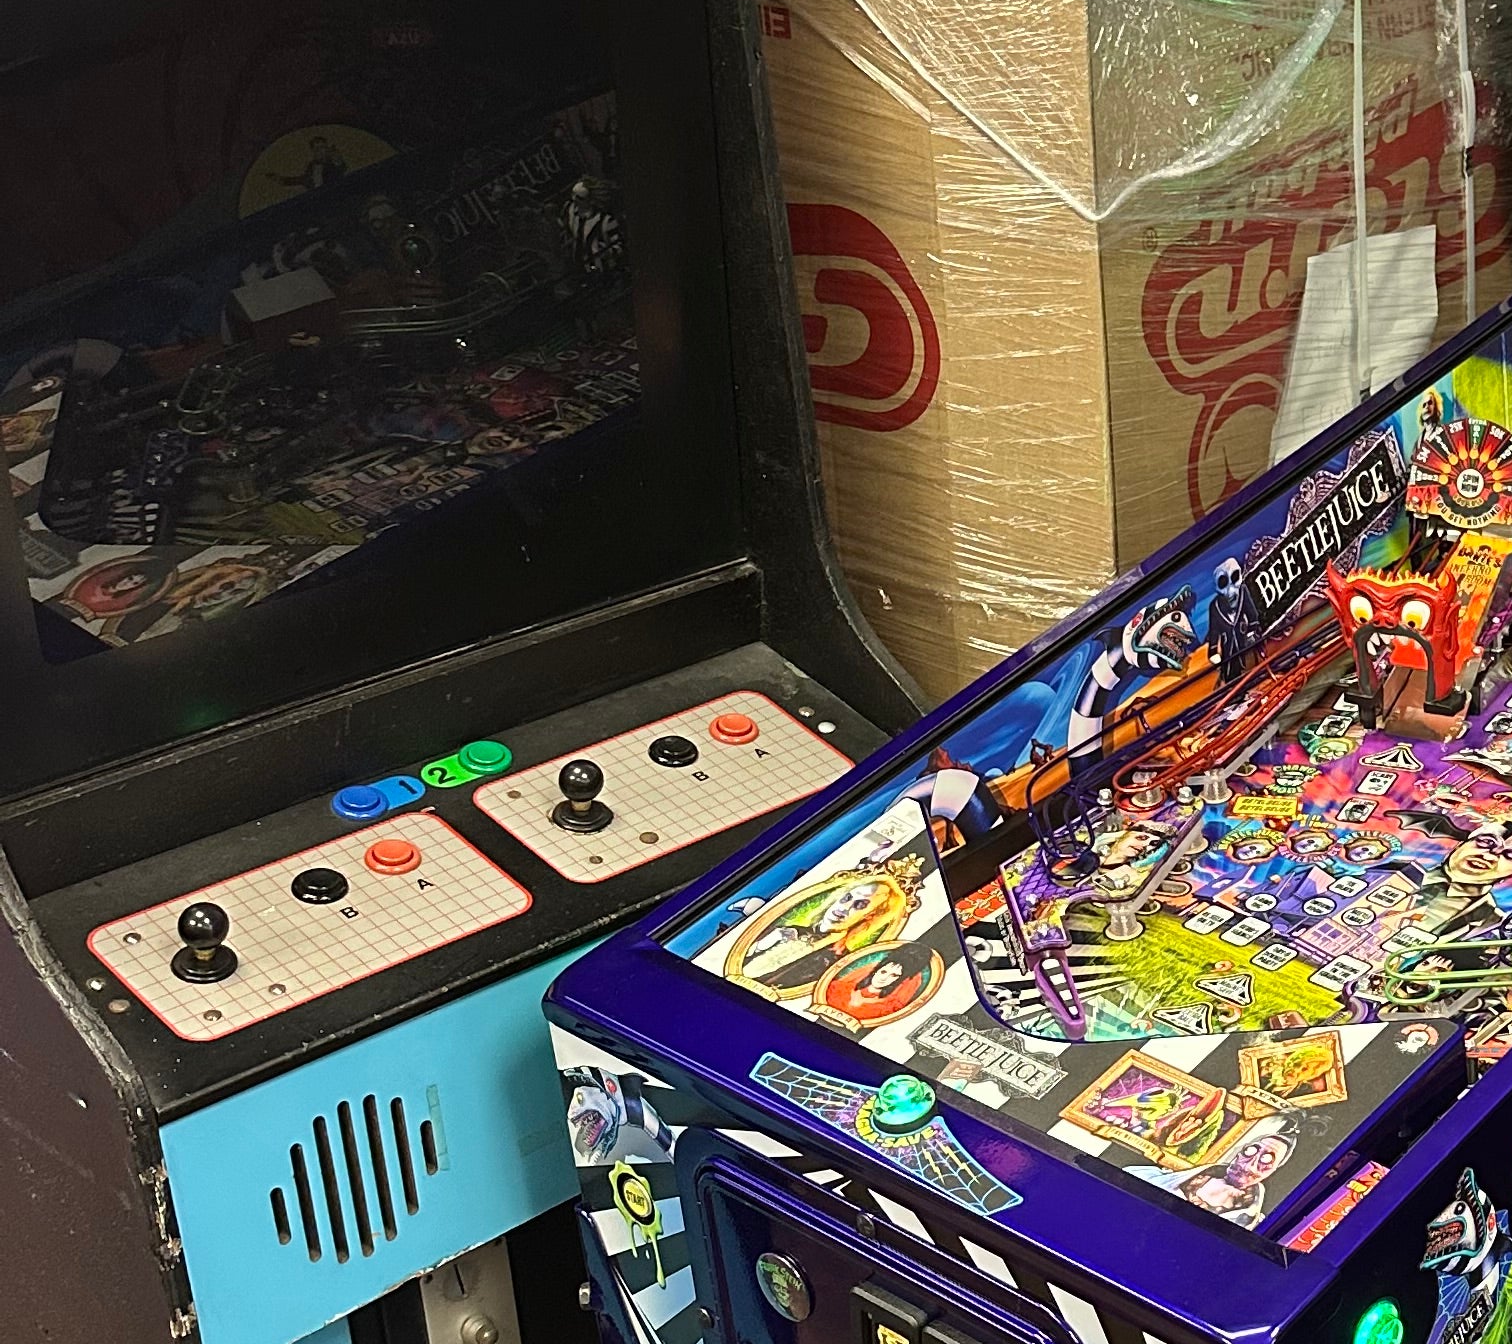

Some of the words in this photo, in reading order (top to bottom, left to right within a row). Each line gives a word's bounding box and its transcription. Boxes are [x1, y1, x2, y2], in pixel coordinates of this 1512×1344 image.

[1254, 459, 1391, 610] BEETLEJUICE
[754, 747, 769, 759] A
[427, 764, 457, 788] 2
[691, 770, 709, 782] B
[418, 878, 433, 892] A
[341, 905, 359, 919] B
[929, 1022, 1046, 1088] BEETLEJUICE
[625, 1186, 646, 1213] START
